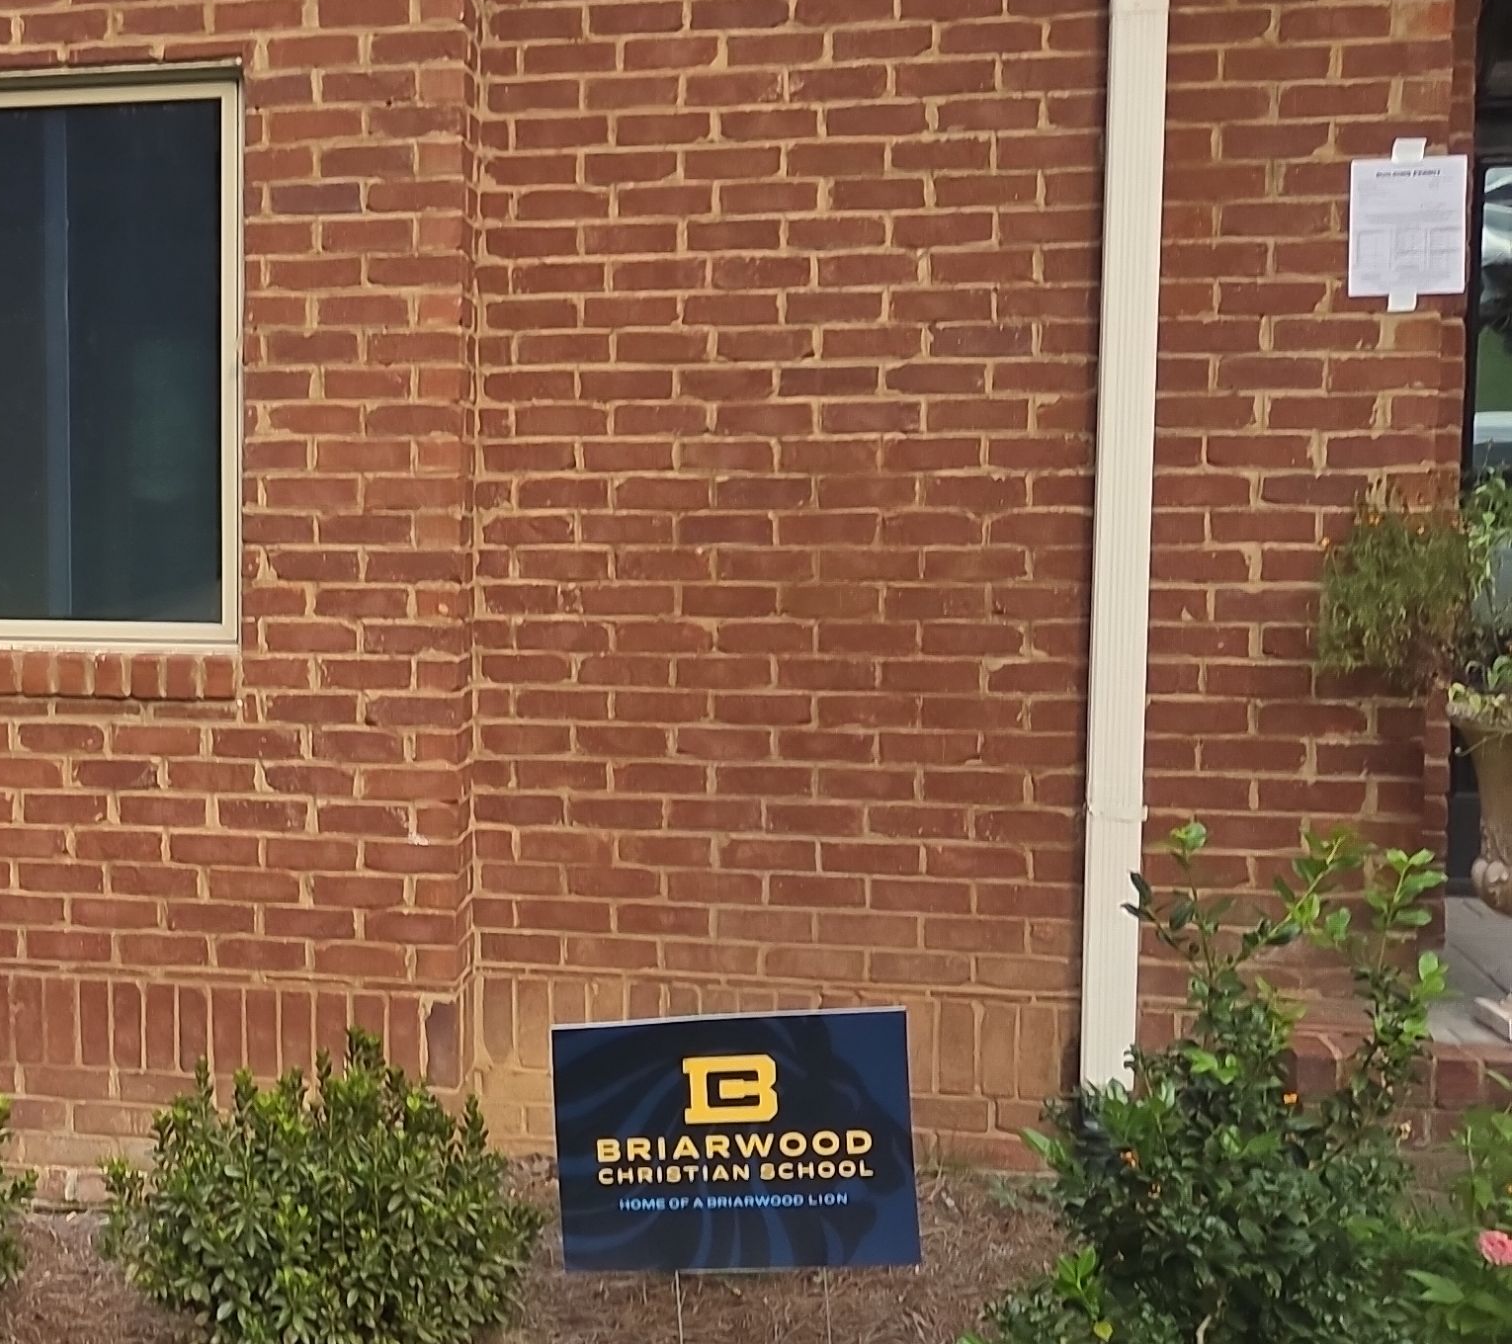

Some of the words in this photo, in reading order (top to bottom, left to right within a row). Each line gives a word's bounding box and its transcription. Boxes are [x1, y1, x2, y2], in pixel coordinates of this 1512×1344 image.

[596, 1129, 873, 1163] BRIARWOOD
[598, 1163, 750, 1185] CHRISTIAN
[760, 1159, 874, 1181] SCHOOL
[619, 1197, 665, 1211] HOME
[669, 1197, 689, 1210] OF
[693, 1197, 703, 1209] A
[707, 1194, 804, 1209] BRIARWOOD
[808, 1192, 848, 1206] LION
